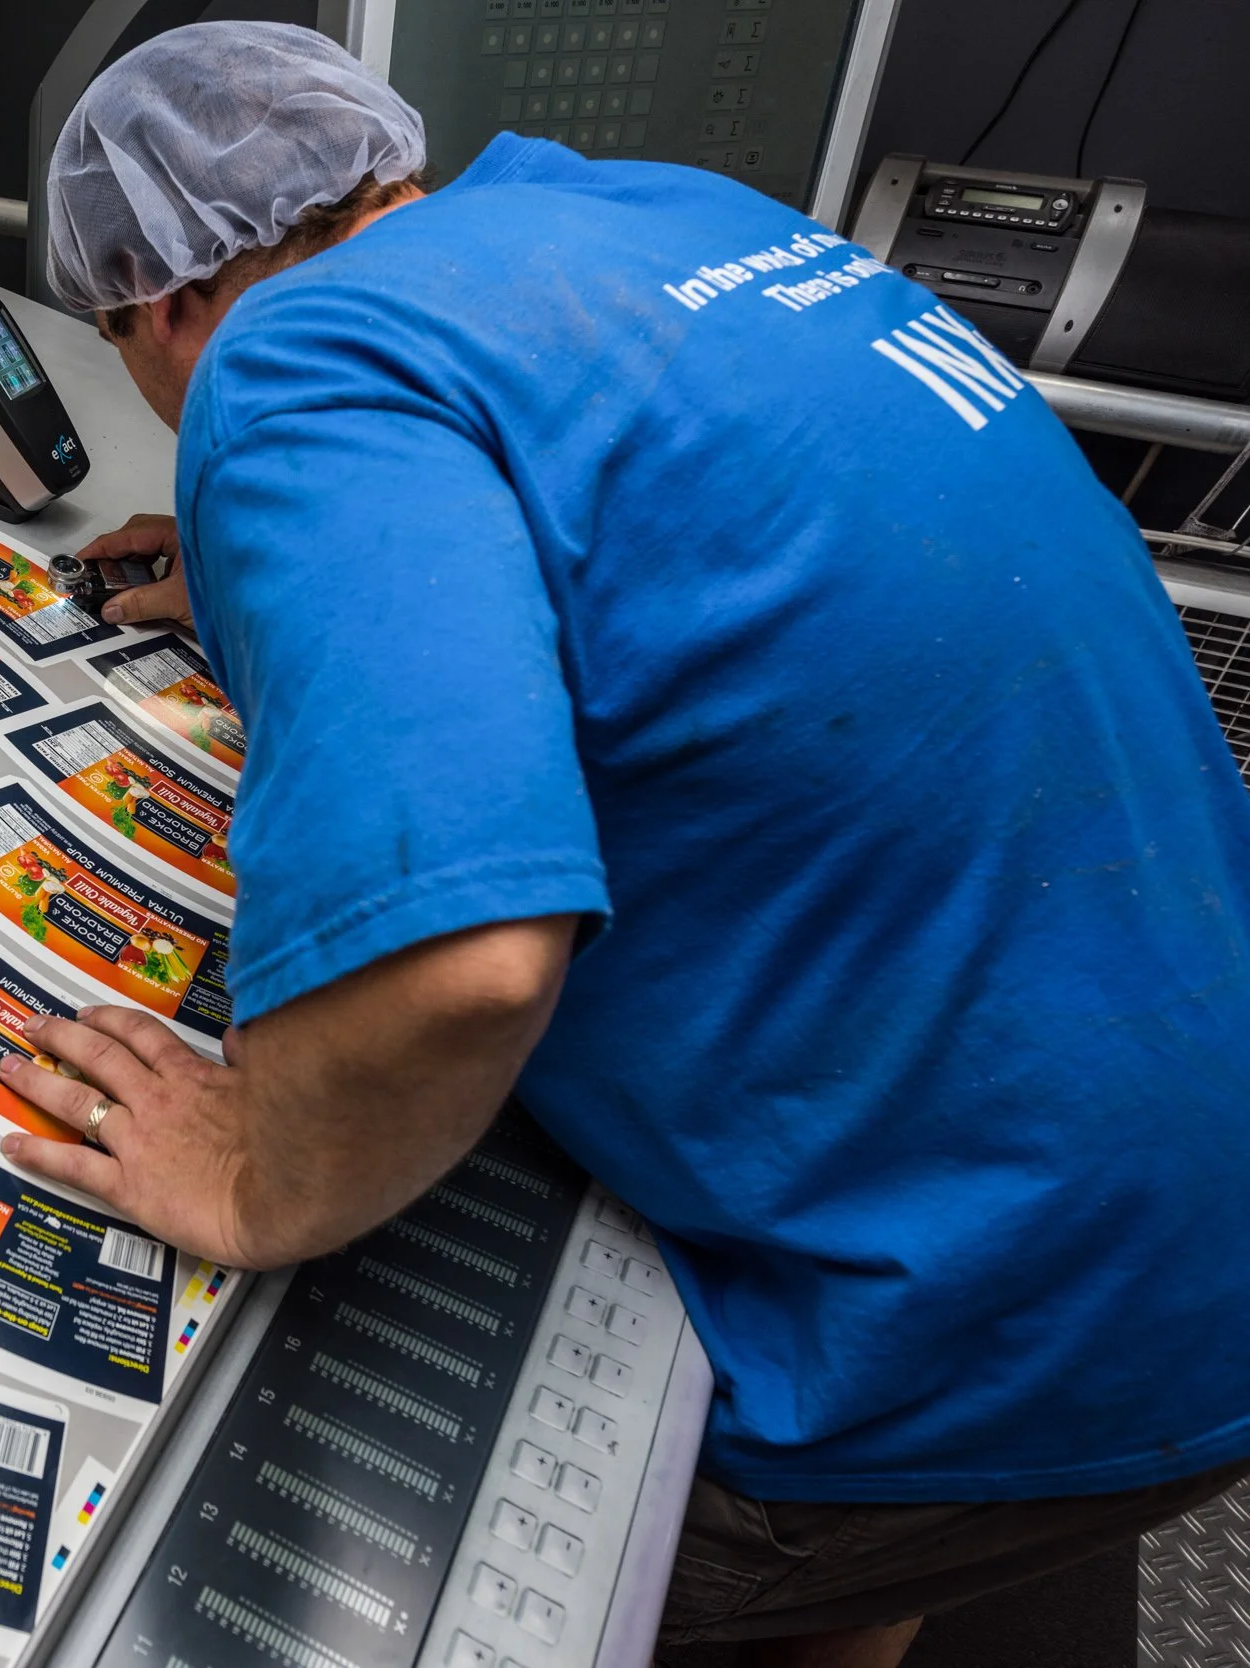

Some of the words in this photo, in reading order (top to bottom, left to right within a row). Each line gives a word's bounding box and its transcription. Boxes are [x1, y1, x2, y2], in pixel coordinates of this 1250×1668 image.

[663, 279, 719, 311] In
[696, 263, 754, 291] the
[790, 233, 825, 258] of
[761, 283, 841, 311] There
[816, 270, 859, 287] is
[871, 305, 1024, 431] INX
[148, 757, 176, 778] SOUP
[157, 787, 181, 804] Chili
[176, 775, 223, 806] PREMIUM
[142, 800, 205, 844] BRADFORD
[179, 799, 218, 827] Vegetable
[150, 817, 199, 851] BROOKE
[66, 847, 101, 877] SOUP
[74, 880, 99, 899] Chili
[94, 866, 145, 907] PREMIUM
[52, 908, 62, 917] &
[56, 896, 124, 945] BRADFORD
[95, 894, 139, 926] Vegetable
[146, 899, 184, 926] ULTRA
[61, 914, 116, 954] BROOKE
[0, 976, 52, 1022] PREMIUM
[0, 1009, 30, 1036] table
[309, 1286, 326, 1302] 17
[285, 1336, 301, 1353] 16
[258, 1388, 276, 1405] 15
[229, 1442, 248, 1461] 14
[200, 1502, 219, 1522] 13
[167, 1565, 188, 1586] 12
[134, 1634, 153, 1656] 11
